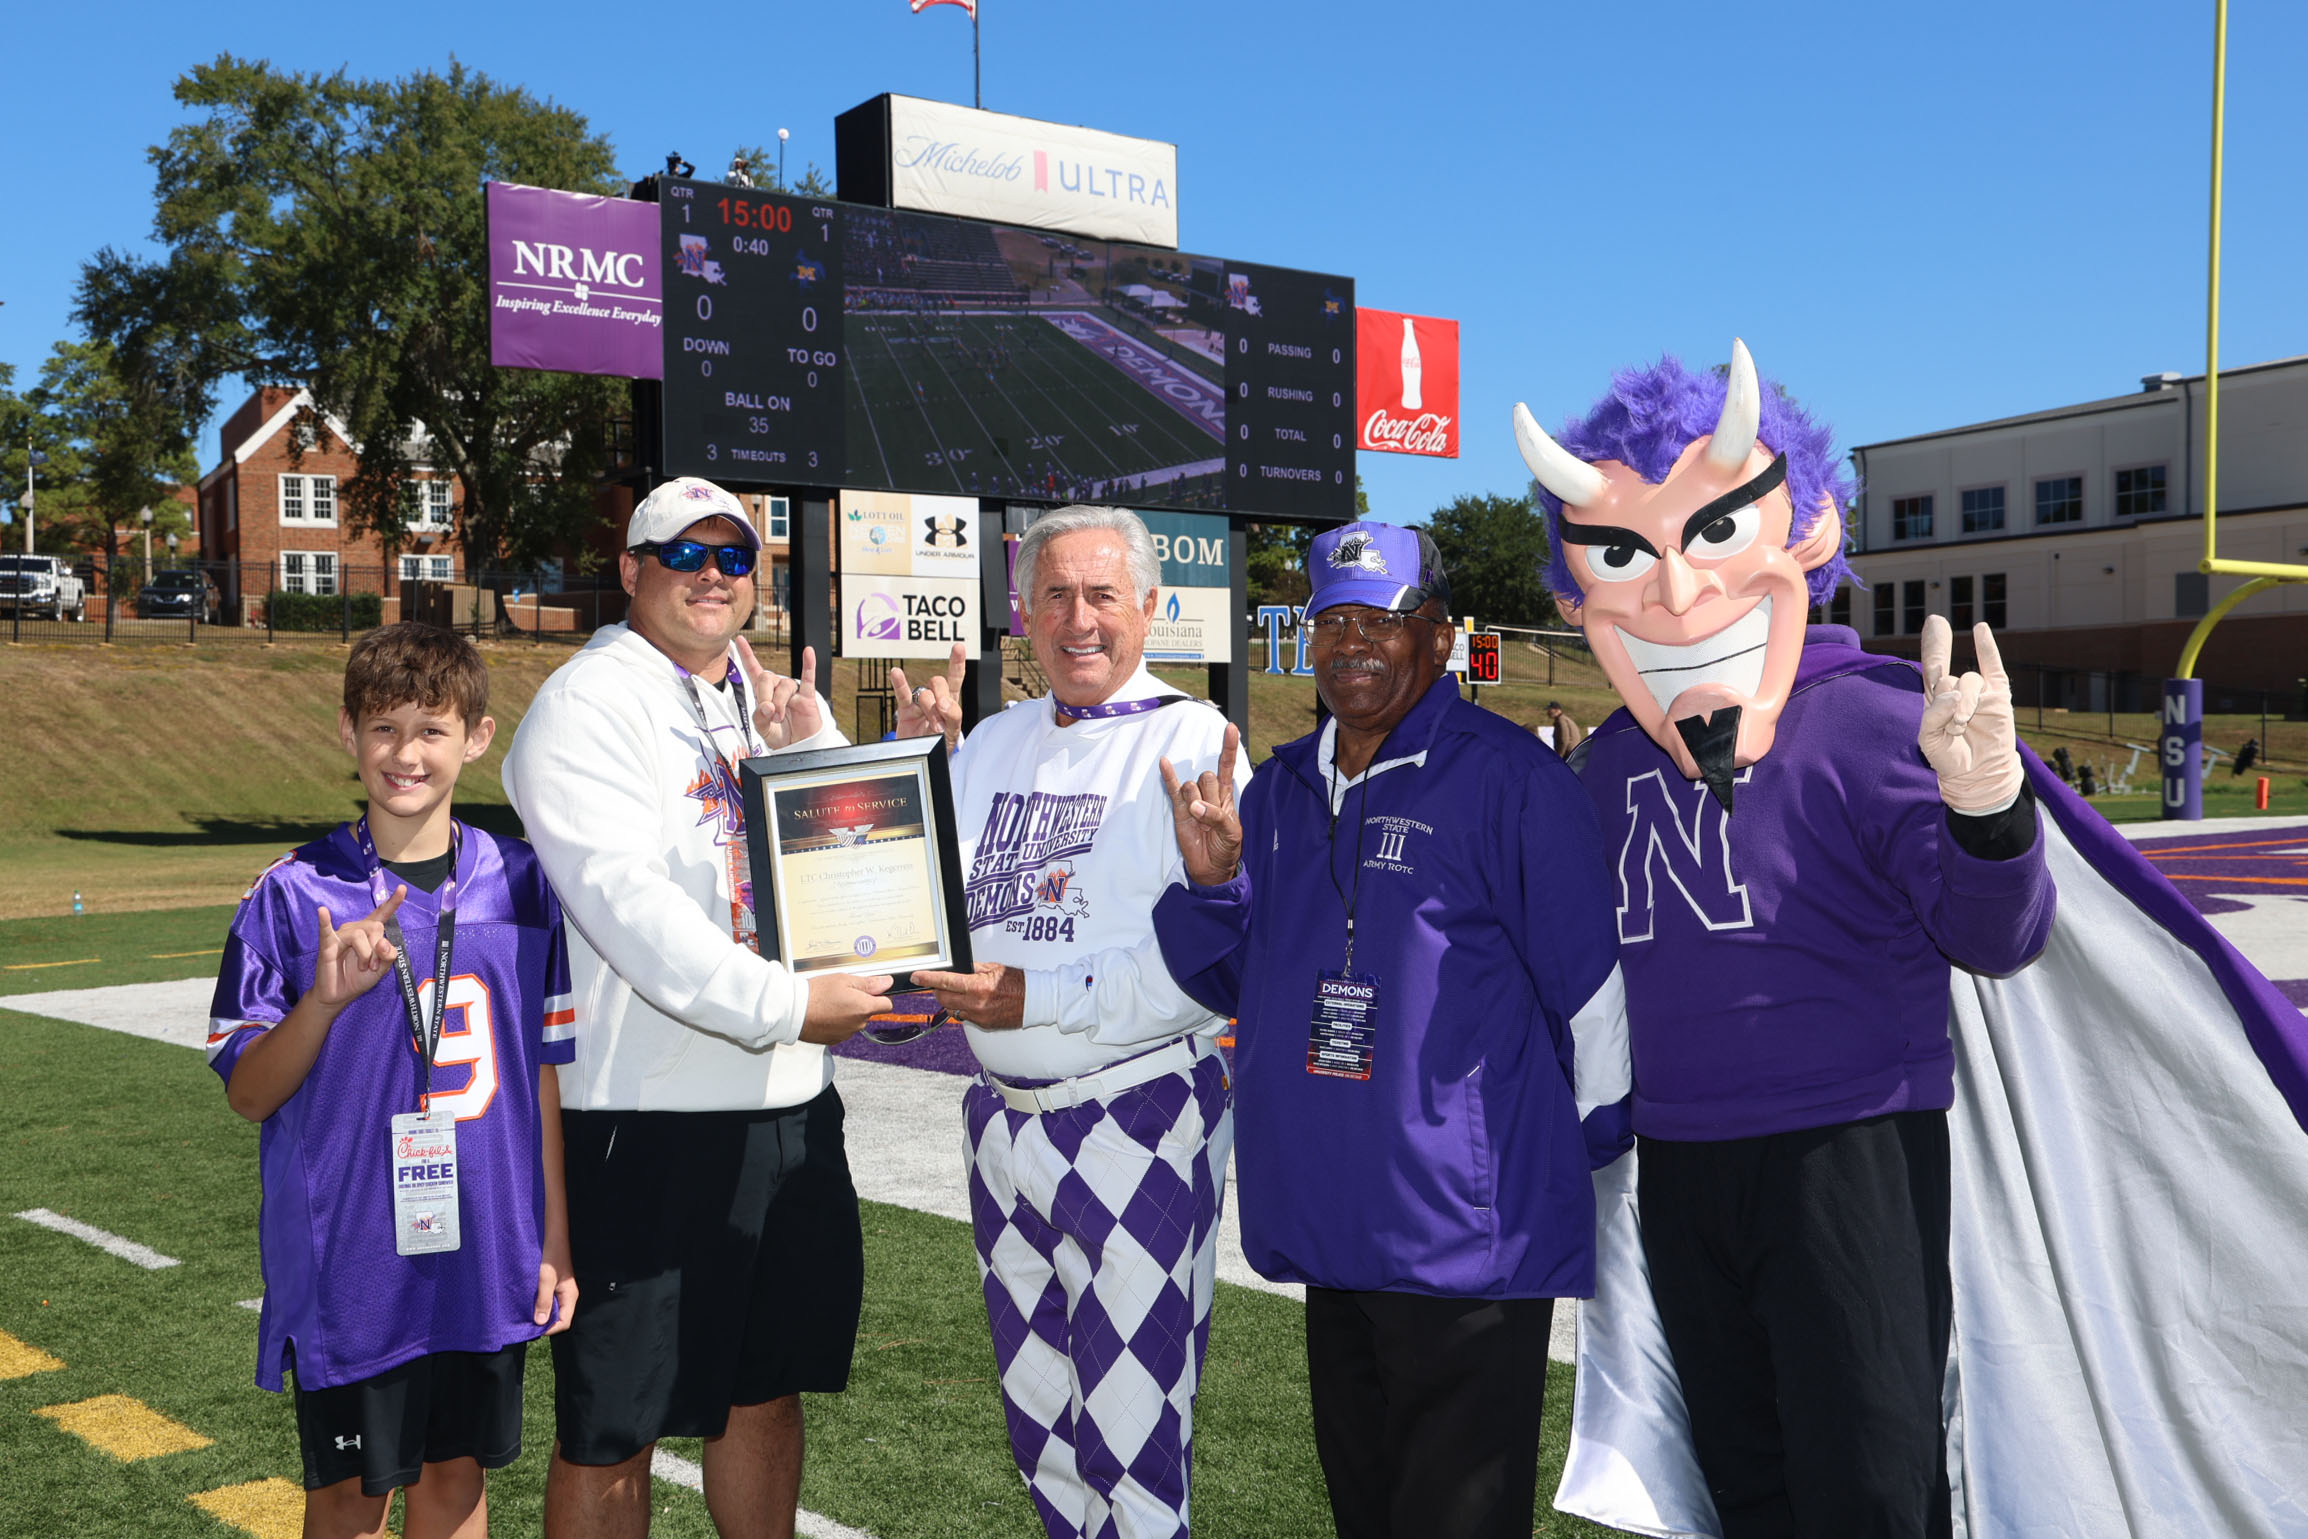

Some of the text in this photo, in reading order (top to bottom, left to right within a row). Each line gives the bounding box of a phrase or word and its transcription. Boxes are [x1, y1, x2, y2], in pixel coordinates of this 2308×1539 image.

[894, 135, 1170, 209] Michelob ULTRA
[670, 186, 694, 199] QTR
[682, 203, 691, 224] 1
[717, 197, 792, 233] 15:00
[812, 206, 834, 219] QTR
[820, 223, 829, 242] 1
[732, 235, 769, 256] 0:40
[512, 239, 645, 288] NRMC
[496, 295, 662, 327] Inspiring Excellence Everyday
[697, 295, 713, 321] 0
[802, 306, 818, 332] 0
[683, 337, 730, 356] DOWN
[787, 348, 836, 366] TO GO
[1239, 338, 1341, 364] 0 PASSING 0
[702, 360, 712, 378] 0
[807, 371, 818, 388] 0
[725, 392, 791, 411] BALL ON
[1240, 382, 1341, 408] 0 RUSHING 0
[749, 416, 769, 434] 35
[1240, 424, 1341, 449] 0 TOTAL 0
[1364, 409, 1451, 453] Coca-Cola
[706, 444, 819, 467] 3 TIMEOUTS 3
[1240, 464, 1343, 485] 0 TURNOVERS 0
[863, 511, 905, 521] LOTT OIL
[915, 550, 941, 558] UNDER
[1150, 534, 1224, 566] BOM
[902, 594, 966, 618] TACO
[908, 619, 966, 642] BELL
[1149, 621, 1203, 638] ouisiana
[1472, 635, 1499, 649] 15:00
[1470, 651, 1498, 680] 40
[2164, 694, 2187, 808] NSU
[794, 806, 841, 821] SALUTE
[856, 797, 908, 811] SERVICE
[1364, 815, 1434, 836] NORTHWESTERN
[1382, 823, 1410, 834] STATE
[969, 828, 1099, 881] STAT UNIVERSITY
[1616, 765, 1754, 945] N
[1362, 859, 1415, 875] ARMY ROTC
[964, 872, 1036, 924] DEMONS
[1044, 877, 1066, 902] N
[1005, 916, 1075, 943] EST. 1884
[400, 968, 421, 1031] NORTHWESTERN
[432, 951, 449, 1039] NORTHWESTERN STATE
[1321, 982, 1374, 998] DEMONS
[397, 1137, 454, 1159] Chick-fil-A
[398, 1163, 454, 1182] FREE
[420, 1219, 431, 1231] N
